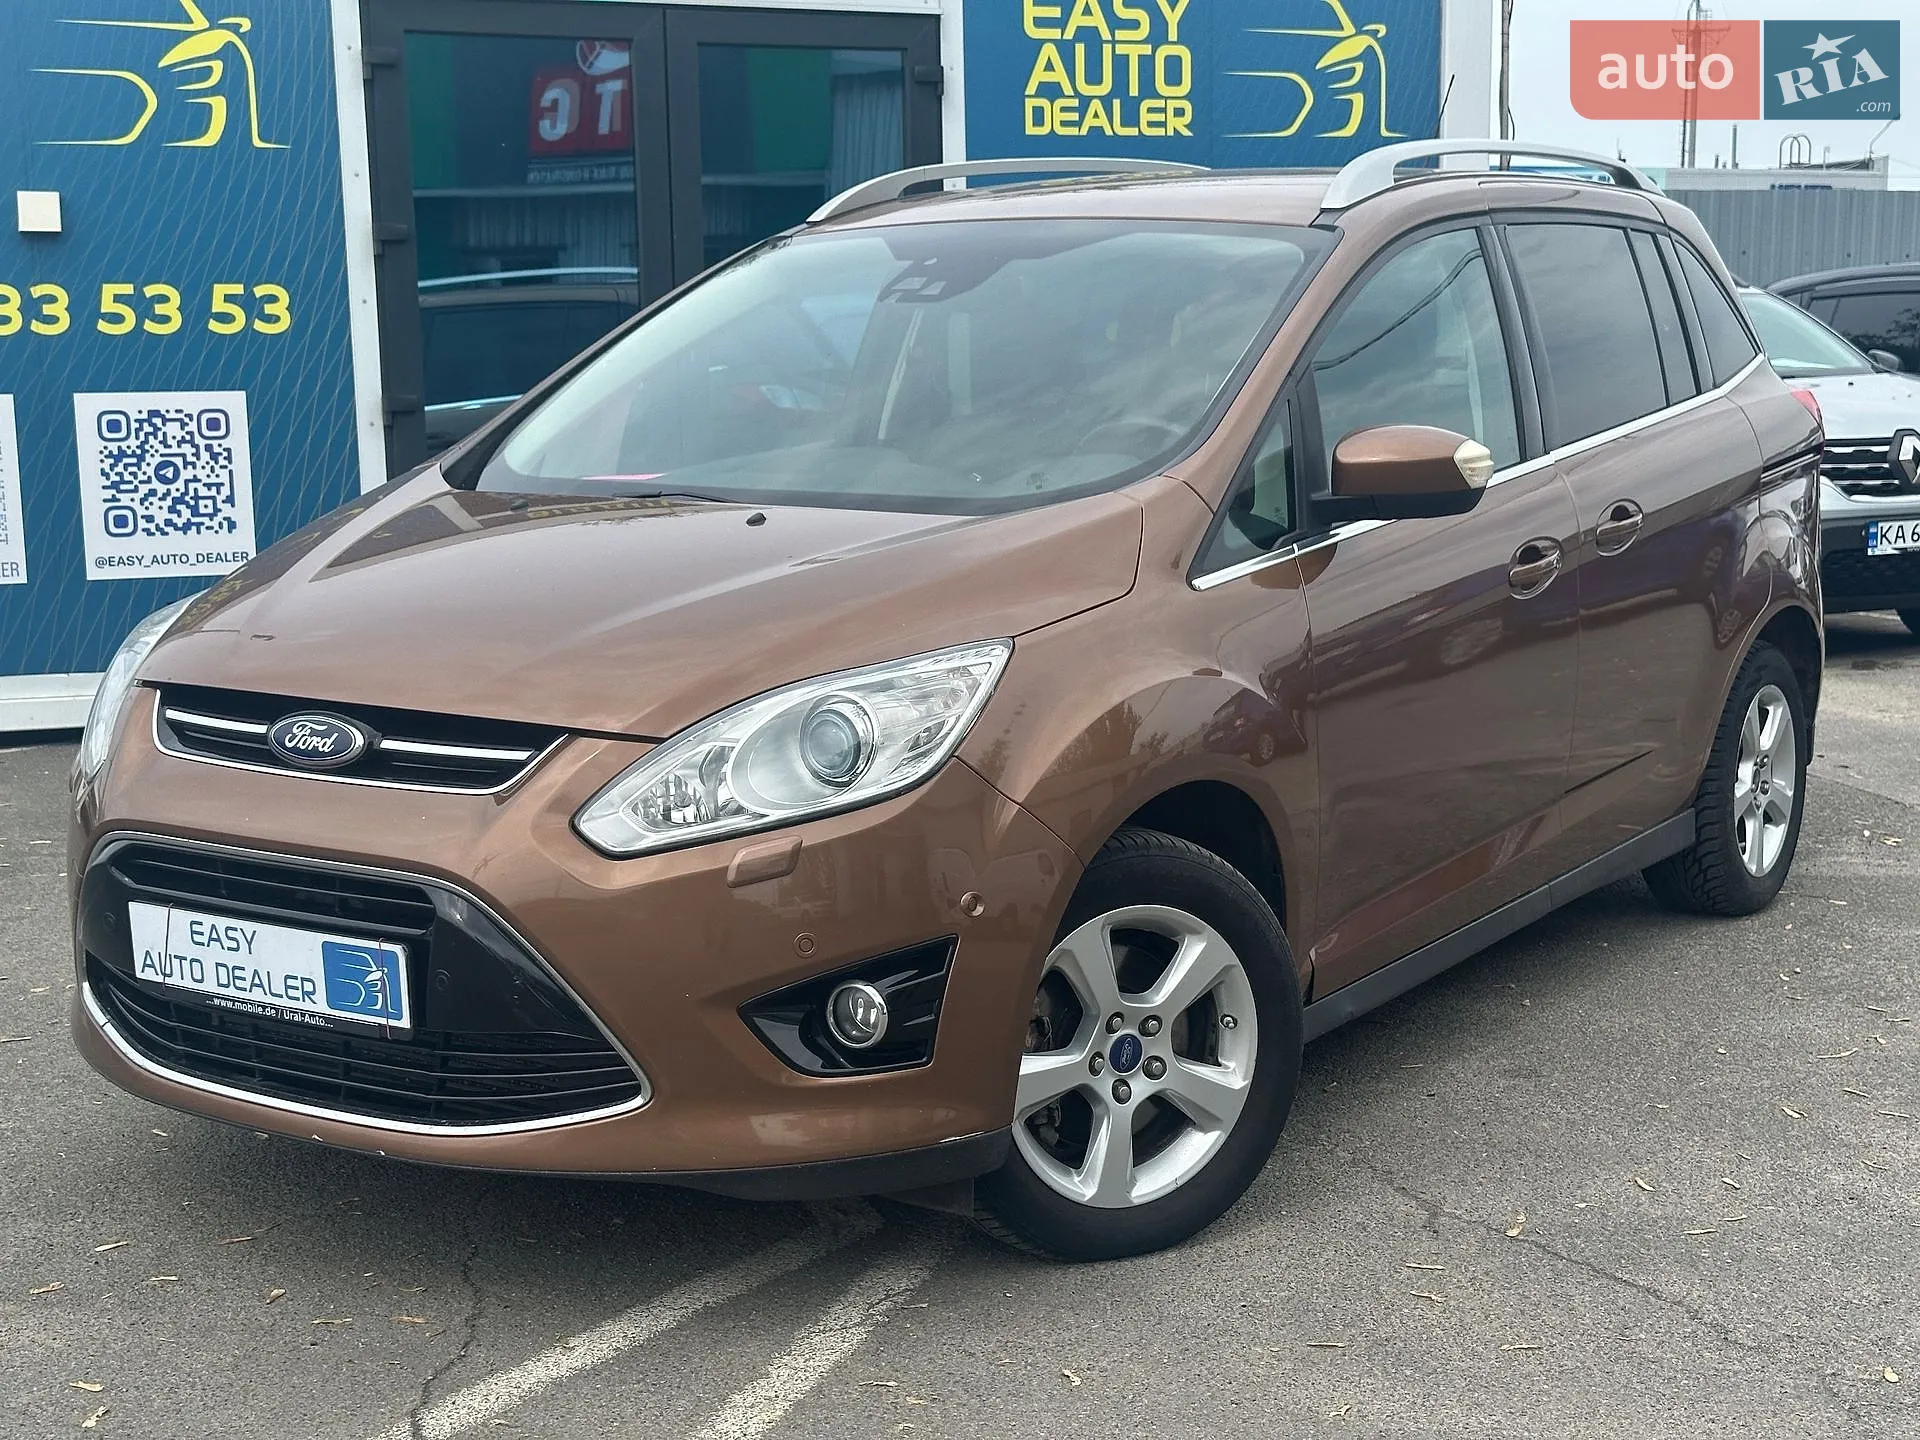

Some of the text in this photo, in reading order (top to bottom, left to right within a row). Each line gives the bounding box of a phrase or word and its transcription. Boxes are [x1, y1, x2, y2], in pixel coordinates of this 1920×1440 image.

[1023, 0, 1190, 41] EASY
[1025, 42, 1193, 97] AUTO
[1024, 98, 1193, 137] DEALER
[96, 283, 183, 335] 53
[207, 283, 292, 335] 53
[1880, 525, 1906, 545] KA
[0, 562, 20, 578] ER
[95, 551, 249, 569] @EASY_AUTO_DEALER
[285, 721, 339, 753] Ford
[190, 920, 257, 955] EASY
[141, 950, 317, 1004] AUTO DEALER
